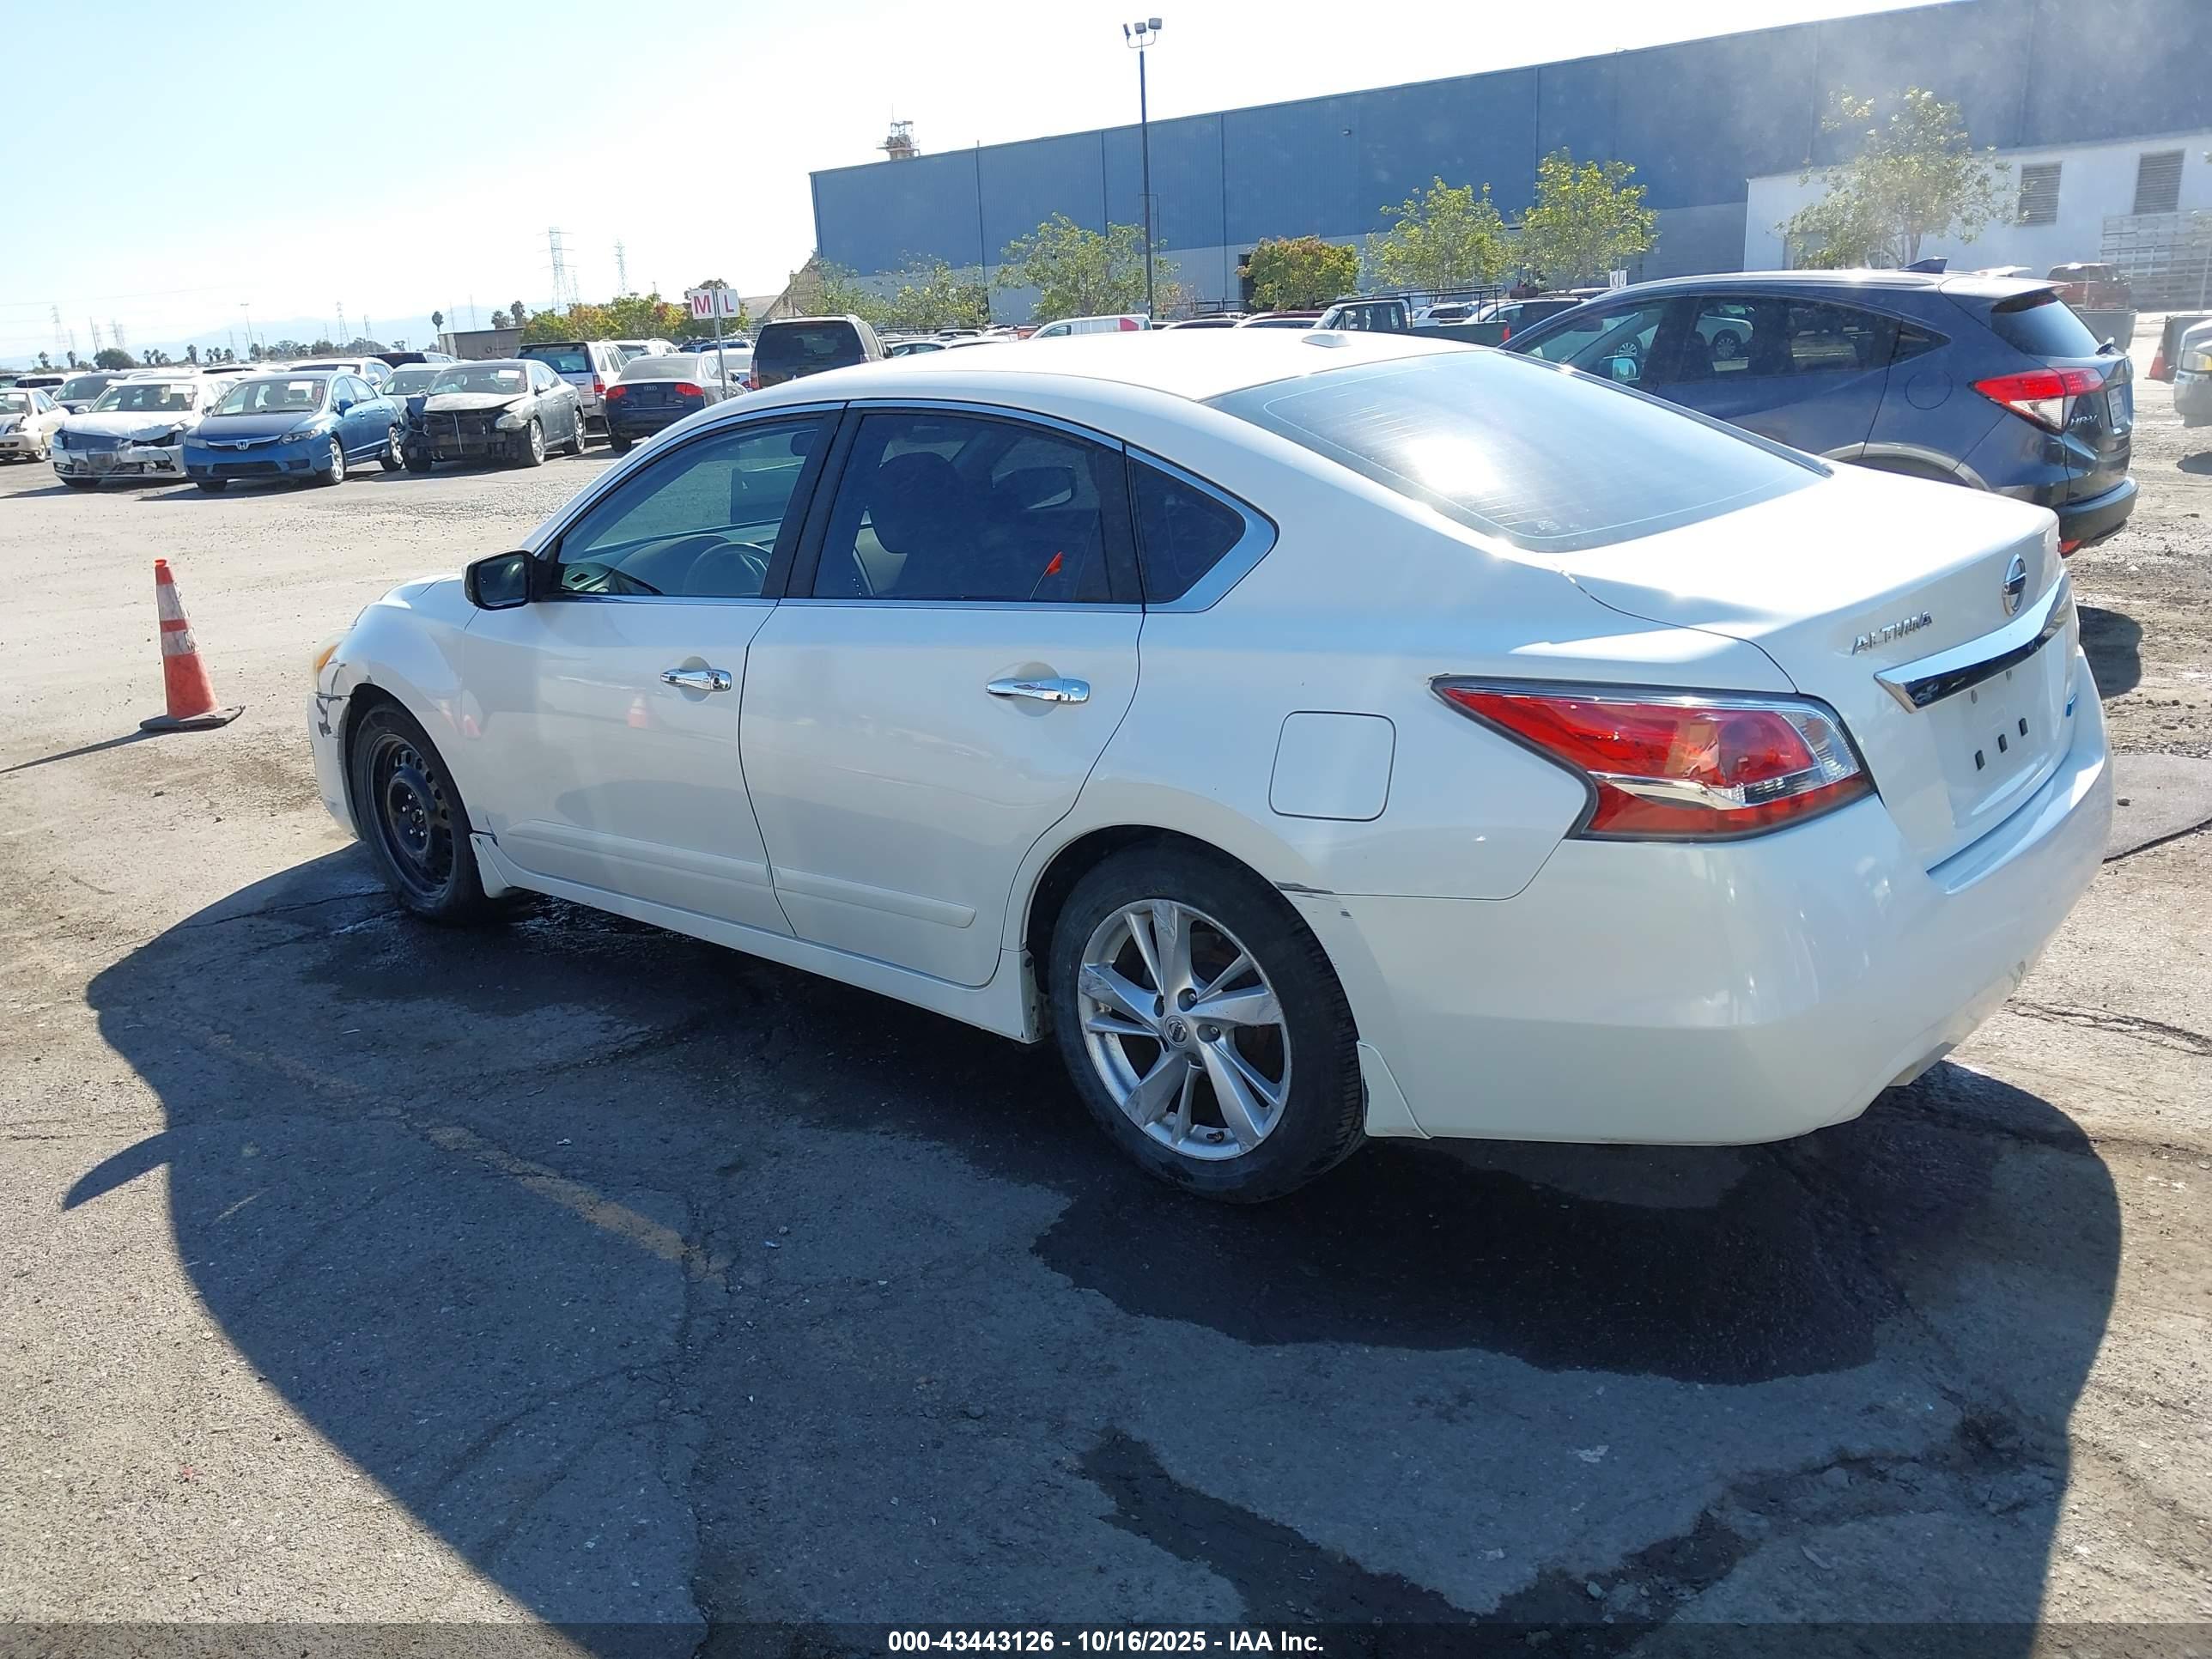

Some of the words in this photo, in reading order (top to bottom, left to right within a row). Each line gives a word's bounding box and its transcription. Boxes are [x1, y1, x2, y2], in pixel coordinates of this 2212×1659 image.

[693, 295, 712, 314] M
[724, 295, 735, 313] L
[2069, 414, 2098, 426] HR-V
[1851, 611, 1933, 655] ALTIMA
